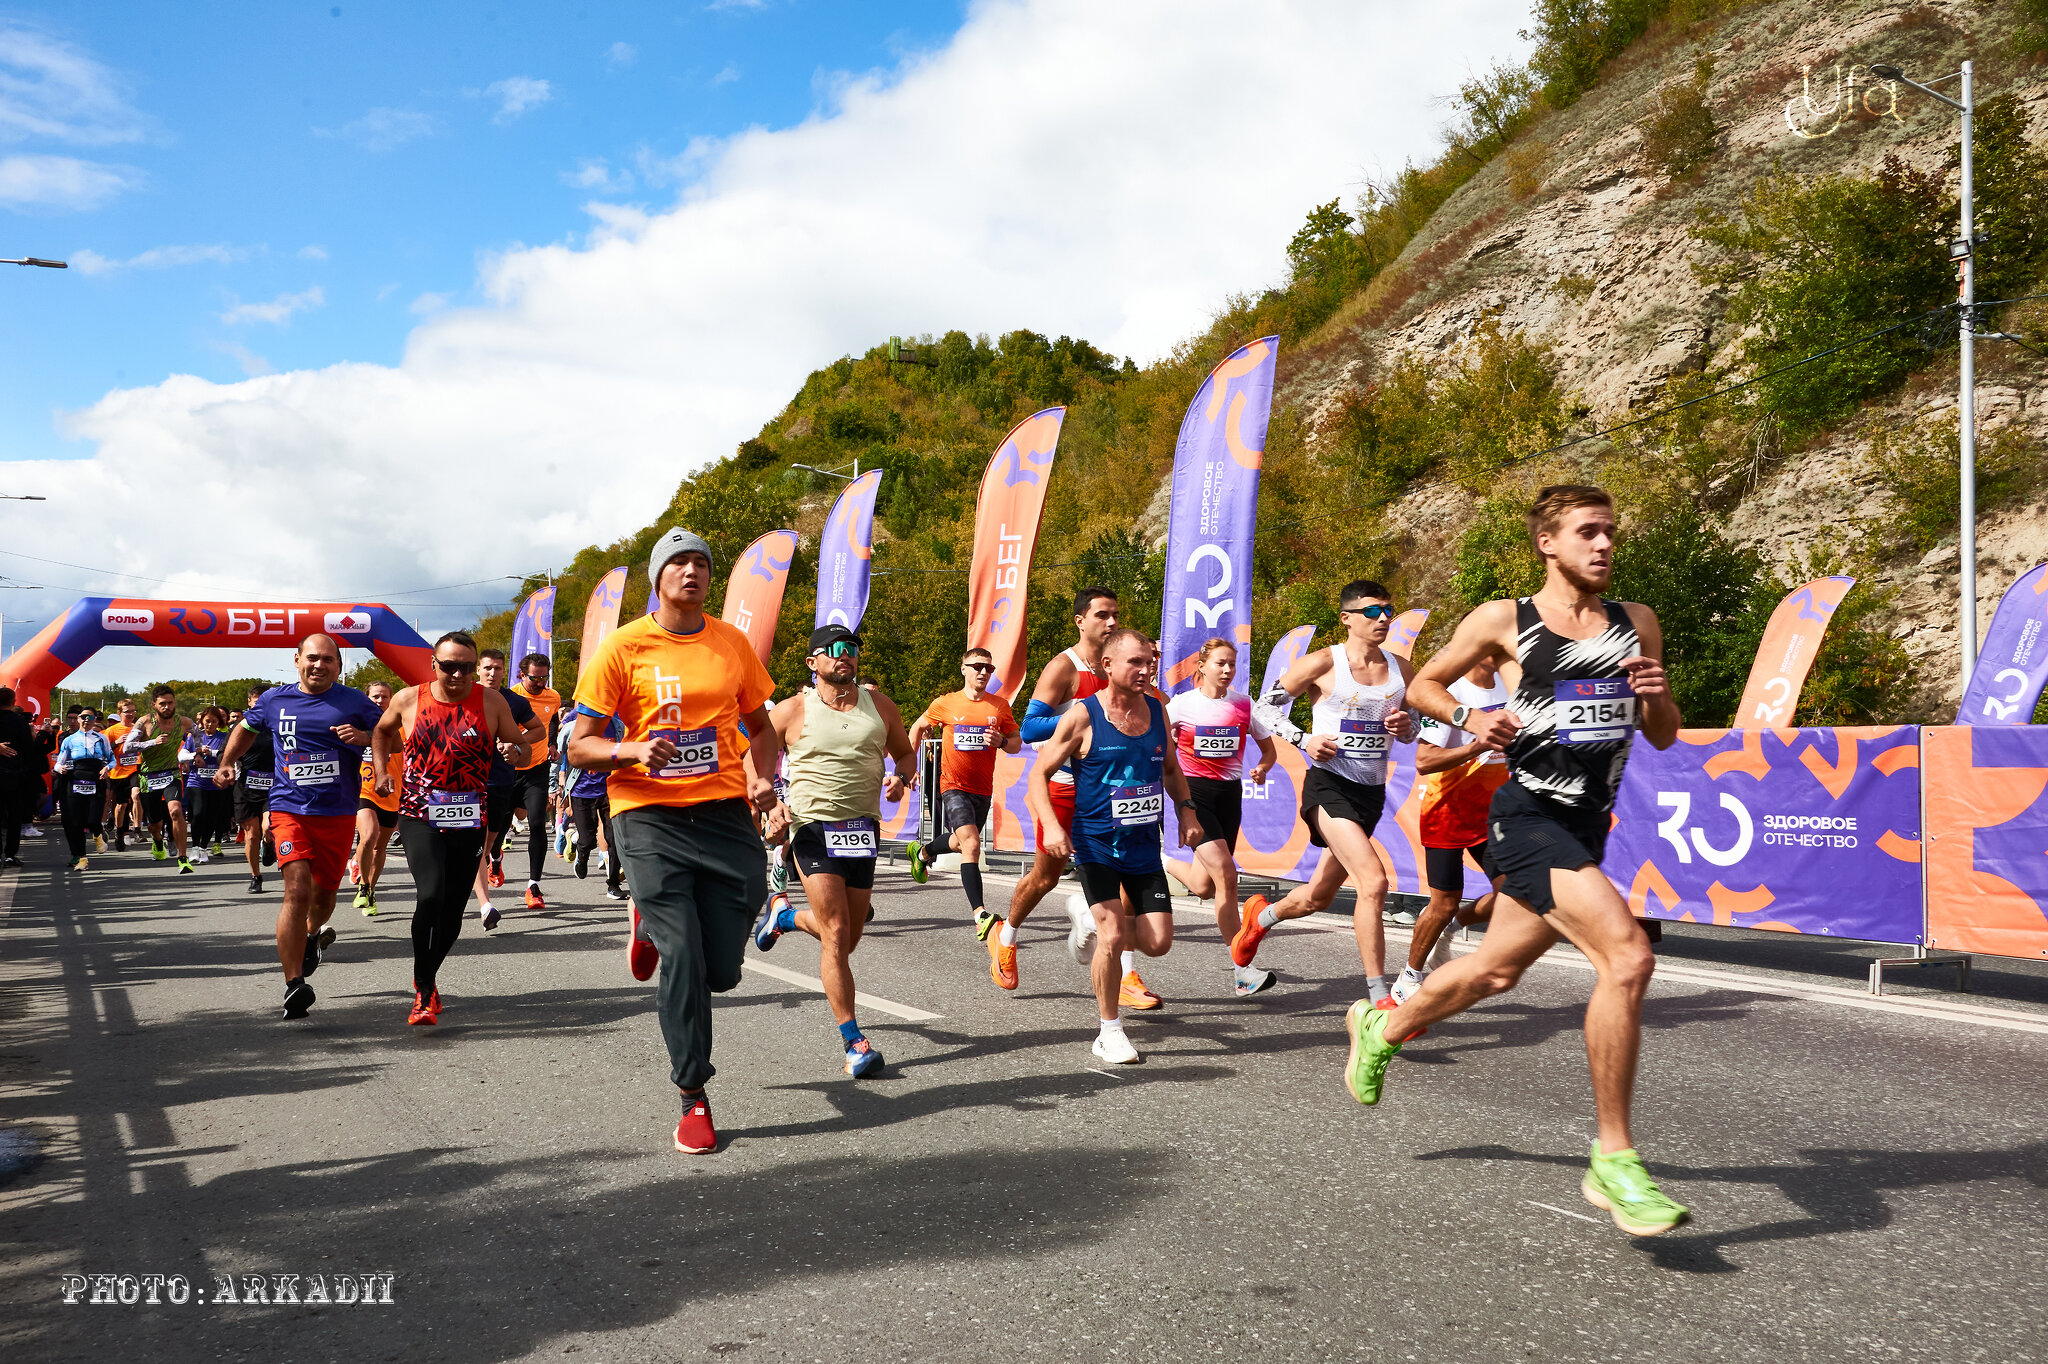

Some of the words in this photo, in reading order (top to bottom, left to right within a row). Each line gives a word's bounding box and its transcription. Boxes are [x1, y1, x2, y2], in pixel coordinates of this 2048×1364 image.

[1200, 461, 1214, 535] ЗДОРОВОЕ
[1210, 461, 1224, 535] ОТЕЧЕСТВО
[995, 523, 1022, 590] БЕГ
[832, 552, 841, 603] ЗДОРОВОЕ
[108, 615, 148, 624] РОЛЬФ
[2012, 617, 2035, 664] ЗДОРОВОЕ
[2020, 620, 2042, 666] ОТЕЧЕСТВО
[1594, 682, 1621, 695] БЕГ
[654, 666, 682, 725] БЕГ
[1569, 703, 1627, 724] 2154
[278, 708, 297, 751] БЕГ
[1364, 723, 1381, 732] БЕГ
[680, 732, 703, 743] БЕГ
[958, 735, 984, 743] 2419
[1200, 739, 1234, 749] 2612
[1344, 735, 1385, 748] 2732
[310, 753, 328, 761] БЕГ
[294, 763, 335, 777] 2754
[248, 777, 271, 785] 2648
[1136, 785, 1154, 795] БЕГ
[451, 795, 468, 803] БЕГ
[435, 807, 474, 818] 2516
[1117, 797, 1159, 815] 2242
[847, 821, 864, 829] БЕГ
[1763, 815, 1858, 830] ЗДОРОВОЕ
[831, 834, 871, 846] 2196
[1763, 832, 1858, 849] ОТЕЧЕСТВО
